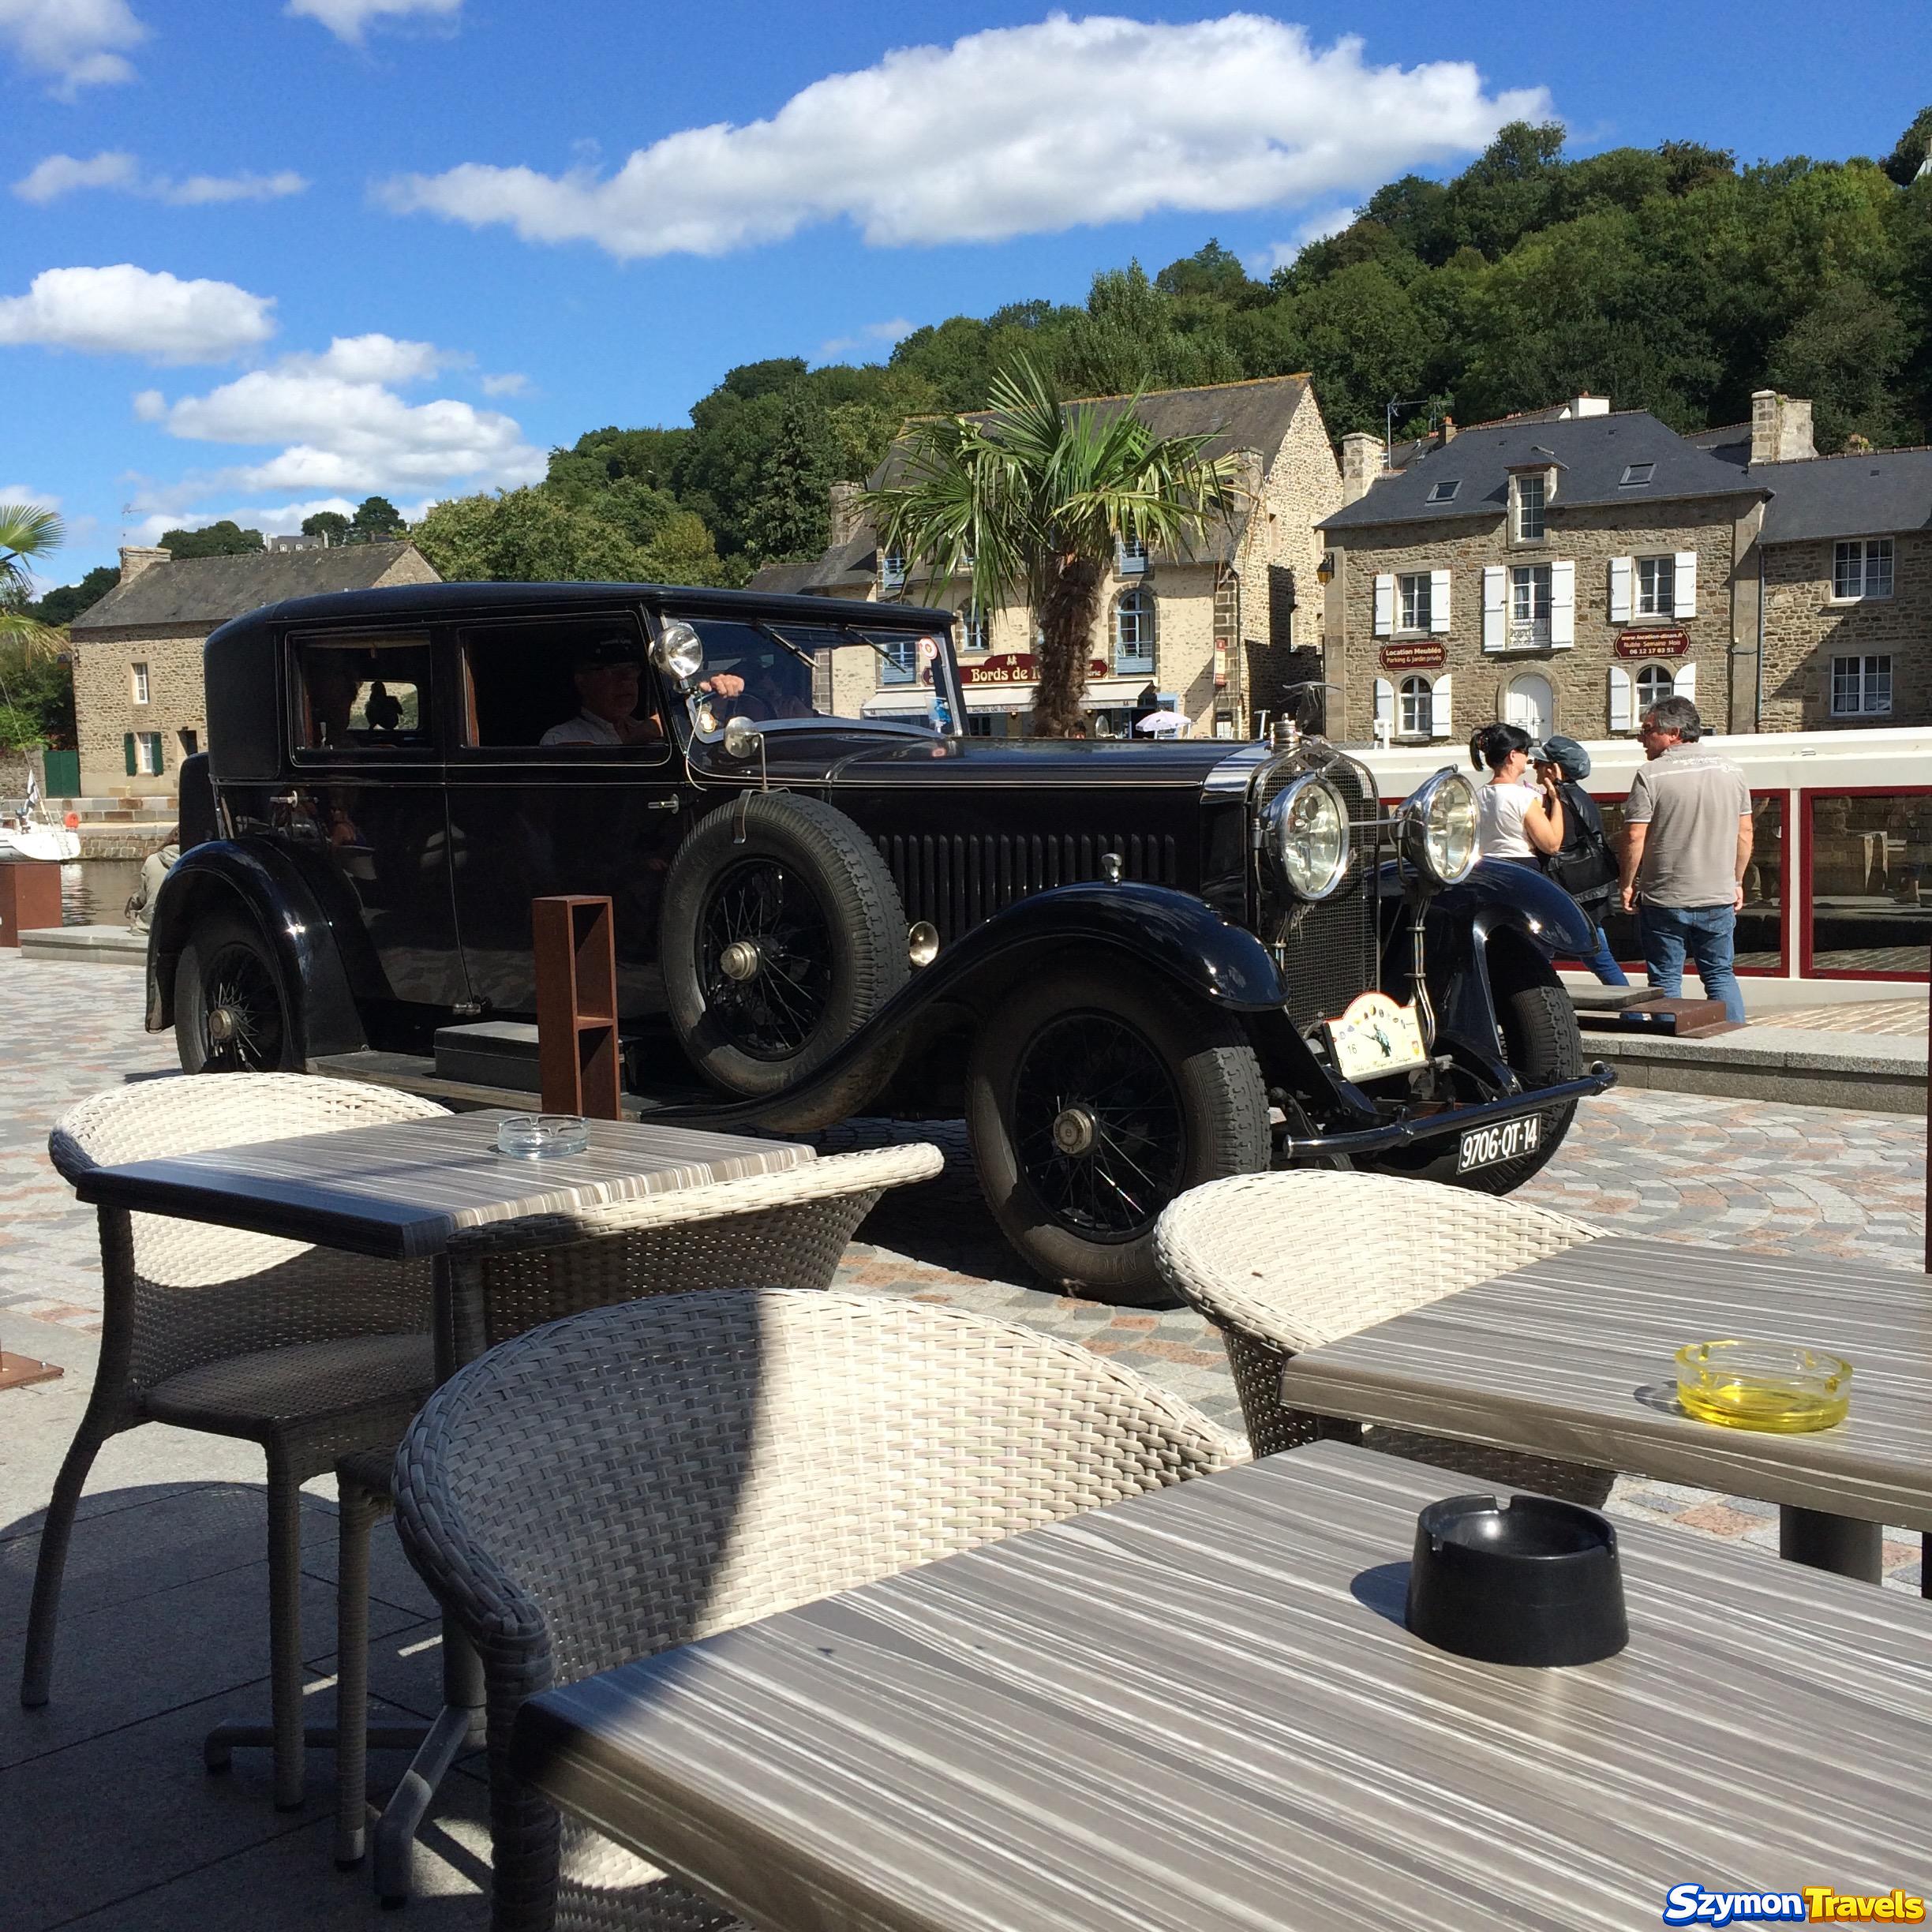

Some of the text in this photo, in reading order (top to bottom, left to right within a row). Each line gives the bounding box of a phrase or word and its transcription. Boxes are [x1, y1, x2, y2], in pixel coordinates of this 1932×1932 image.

[971, 668, 1009, 682] Bords
[1012, 666, 1028, 680] de
[1347, 1043, 1357, 1054] 16
